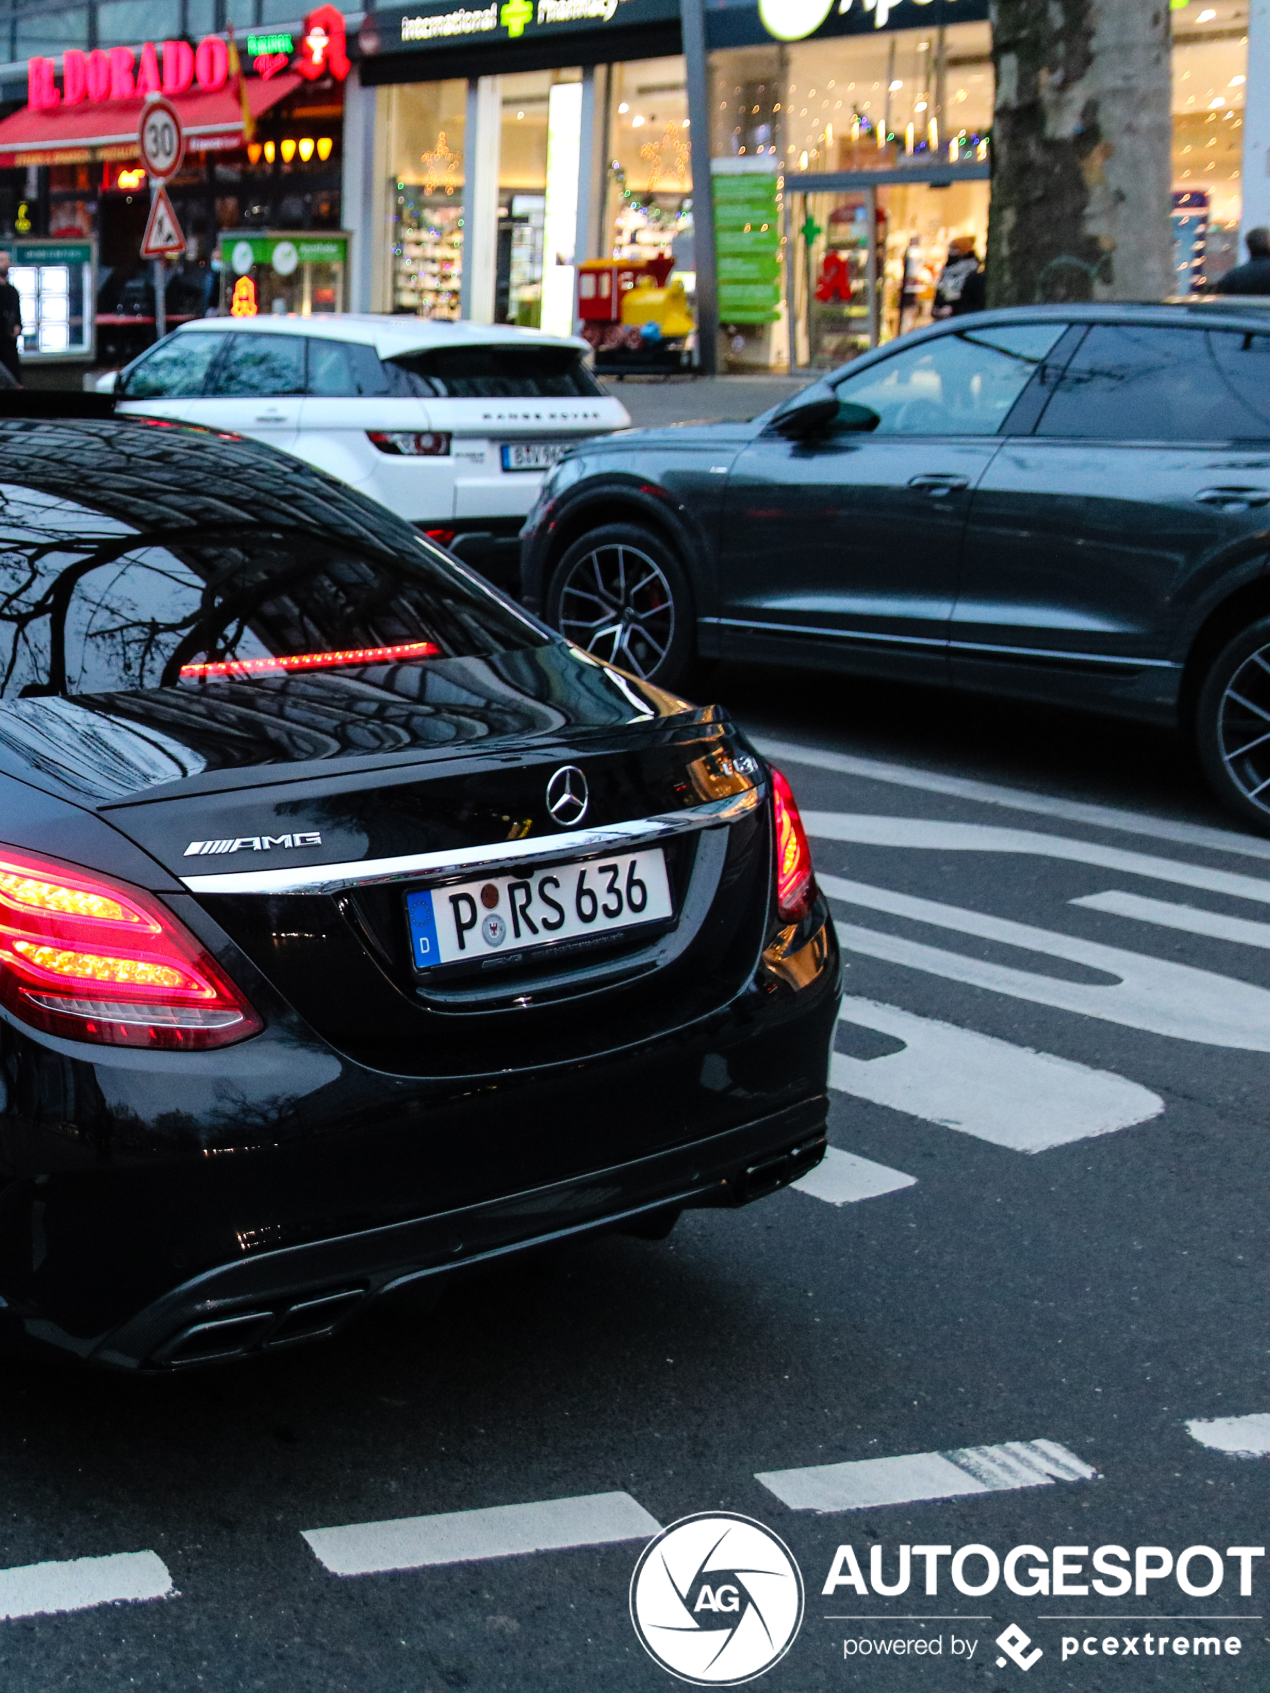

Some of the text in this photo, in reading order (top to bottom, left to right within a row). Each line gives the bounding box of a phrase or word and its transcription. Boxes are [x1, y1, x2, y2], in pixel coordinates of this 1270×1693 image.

[401, 0, 619, 41] International Pharmacy
[149, 122, 174, 158] 30
[229, 831, 322, 853] AMG
[448, 859, 648, 950] P RS 636
[419, 936, 430, 954] D
